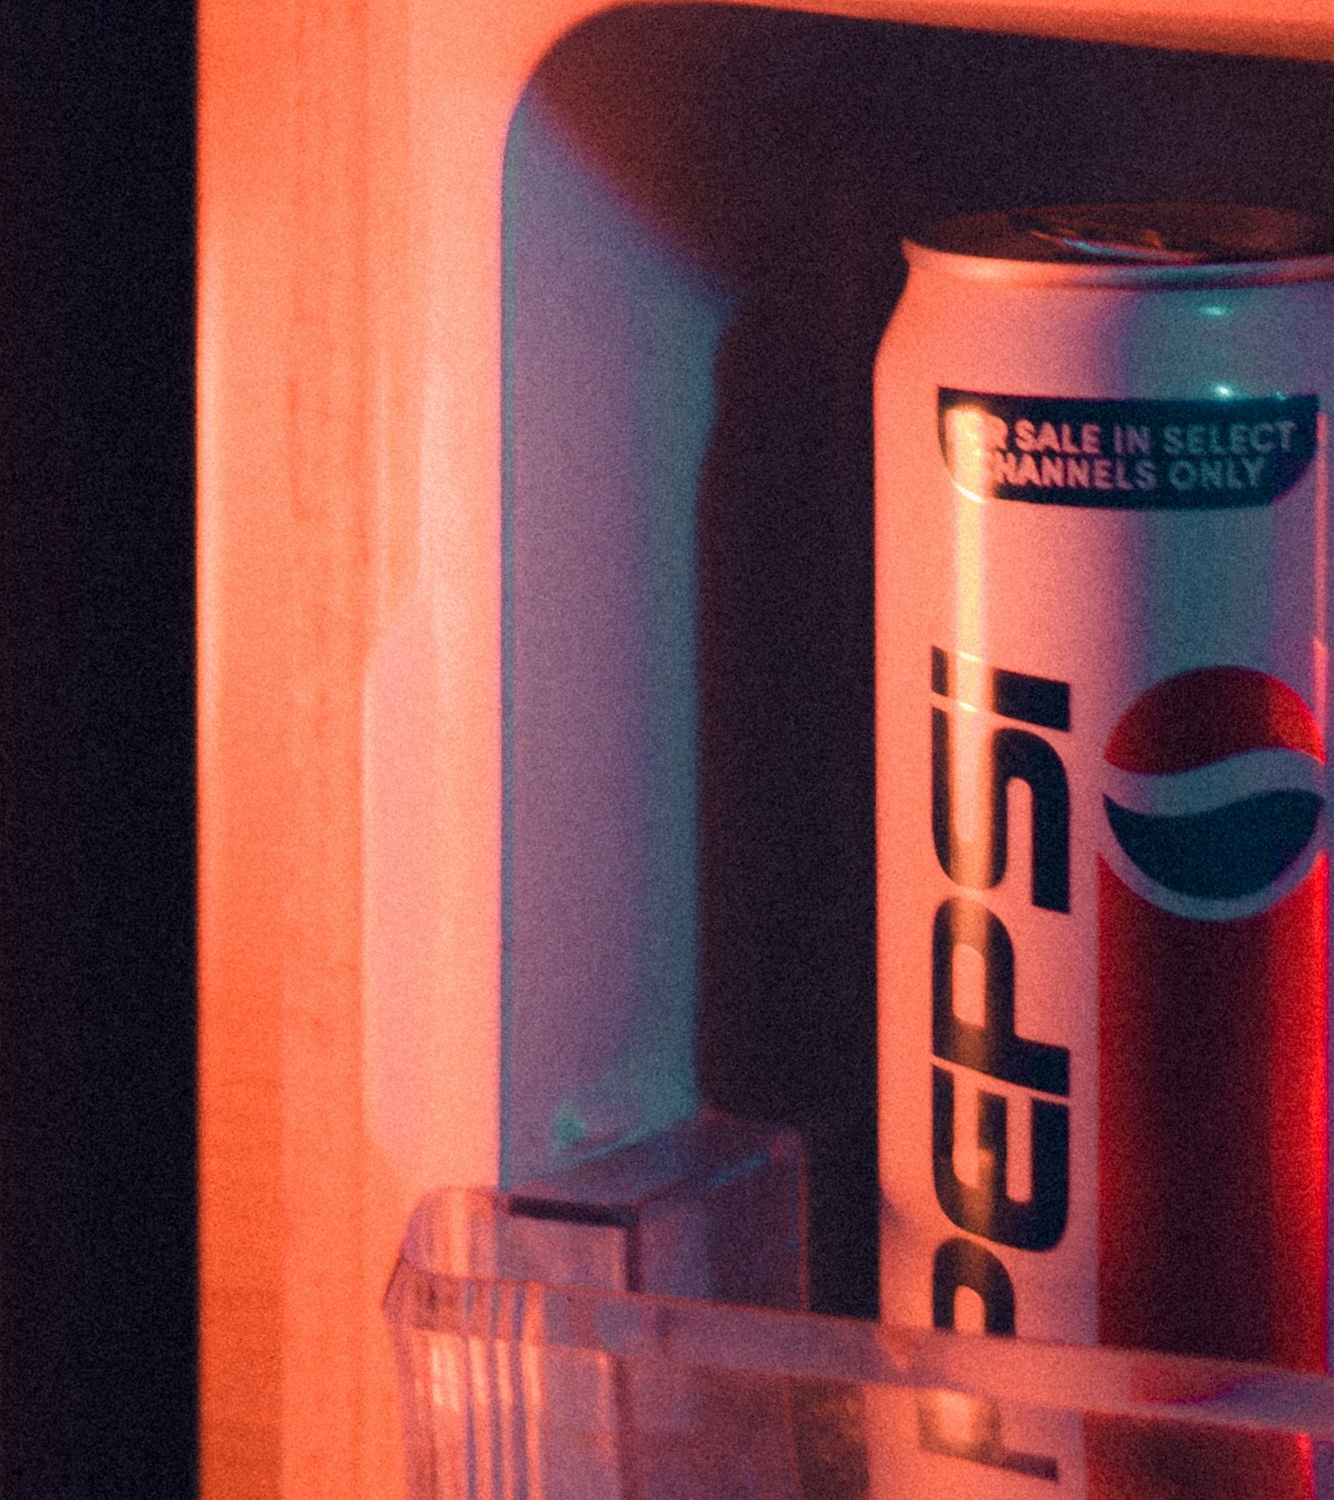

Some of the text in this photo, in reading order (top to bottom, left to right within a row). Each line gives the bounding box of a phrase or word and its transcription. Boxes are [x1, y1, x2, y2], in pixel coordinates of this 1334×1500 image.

[1015, 419, 1100, 454] SALE
[1113, 425, 1152, 454] IN
[1163, 420, 1297, 456] SELECT
[979, 452, 1267, 491] HANNELS ONLY
